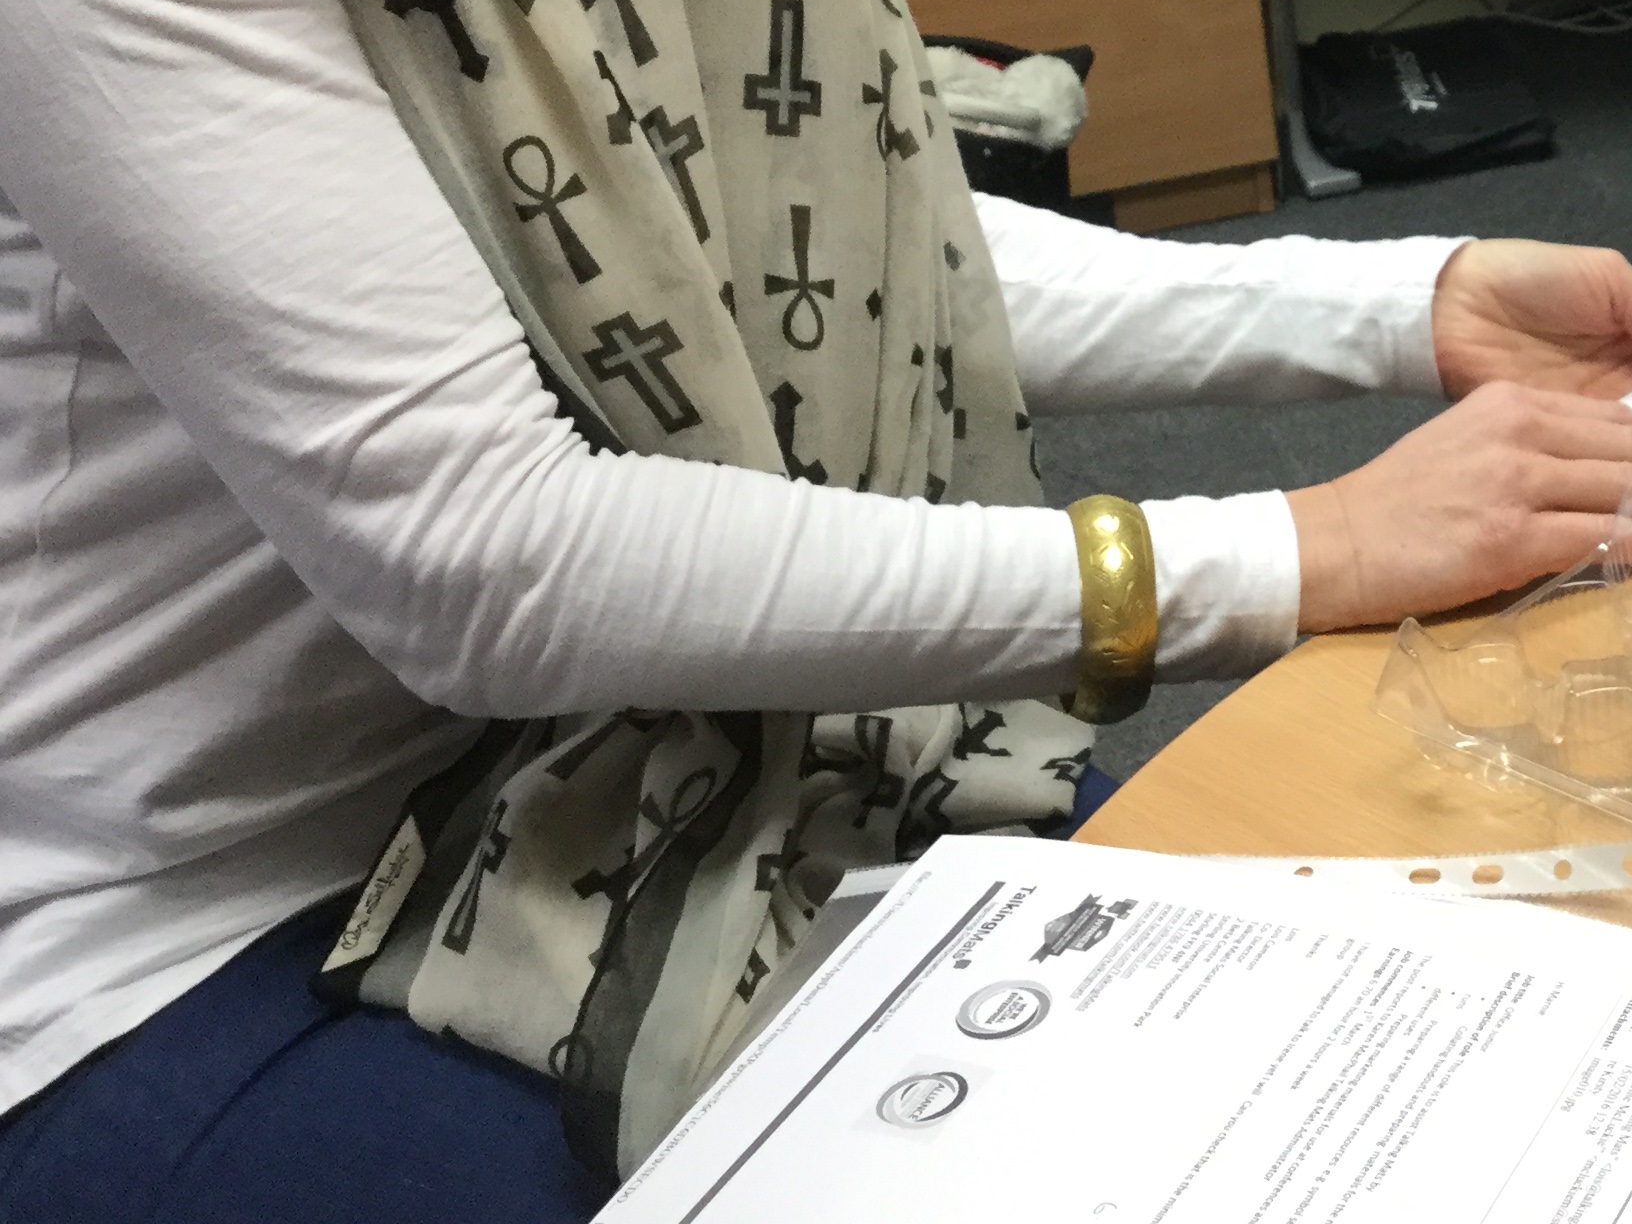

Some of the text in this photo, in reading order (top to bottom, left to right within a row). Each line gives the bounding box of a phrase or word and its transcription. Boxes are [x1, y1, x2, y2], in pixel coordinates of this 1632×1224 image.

[958, 883, 1039, 961] TalkingMats
[1170, 920, 1259, 1020] Talking Mats Social Enterprise
[1244, 939, 1276, 971] Cameron
[1349, 945, 1368, 963] have
[1403, 968, 1422, 984] post
[1313, 977, 1345, 1010] managed
[1339, 964, 1404, 1046] commences March
[1384, 985, 1410, 1012] reports
[994, 1000, 1020, 1024] SOCIAL
[1131, 1011, 1152, 1027] Park
[1288, 947, 1400, 1090] Earnings hour hours week
[1297, 1019, 1314, 1032] talk
[1401, 987, 1444, 1036] different uses
[1478, 974, 1536, 1052] Job Office Junior
[1363, 1022, 1384, 1043] Karen
[1249, 1081, 1267, 1095] will
[1315, 1077, 1345, 1105] Talking
[1364, 971, 1521, 1192] Brief description of role This role to assist Talking Mats by
[1559, 1056, 1604, 1112] image010.jpg
[1587, 1069, 1613, 1095] Kirsty
[906, 1082, 947, 1121] ALLIANCE
[1258, 1013, 1408, 1212] Preparing marketing materials for at conferences
[1291, 1019, 1439, 1216] Preparing range of different resources symbol
[1301, 1105, 1324, 1126] Mats
[1329, 1025, 1469, 1218] Collating handouts and preparing materials for the
[1203, 1131, 1229, 1155] check
[1261, 1126, 1309, 1182] Administrator
[1190, 1155, 1211, 1173] that
